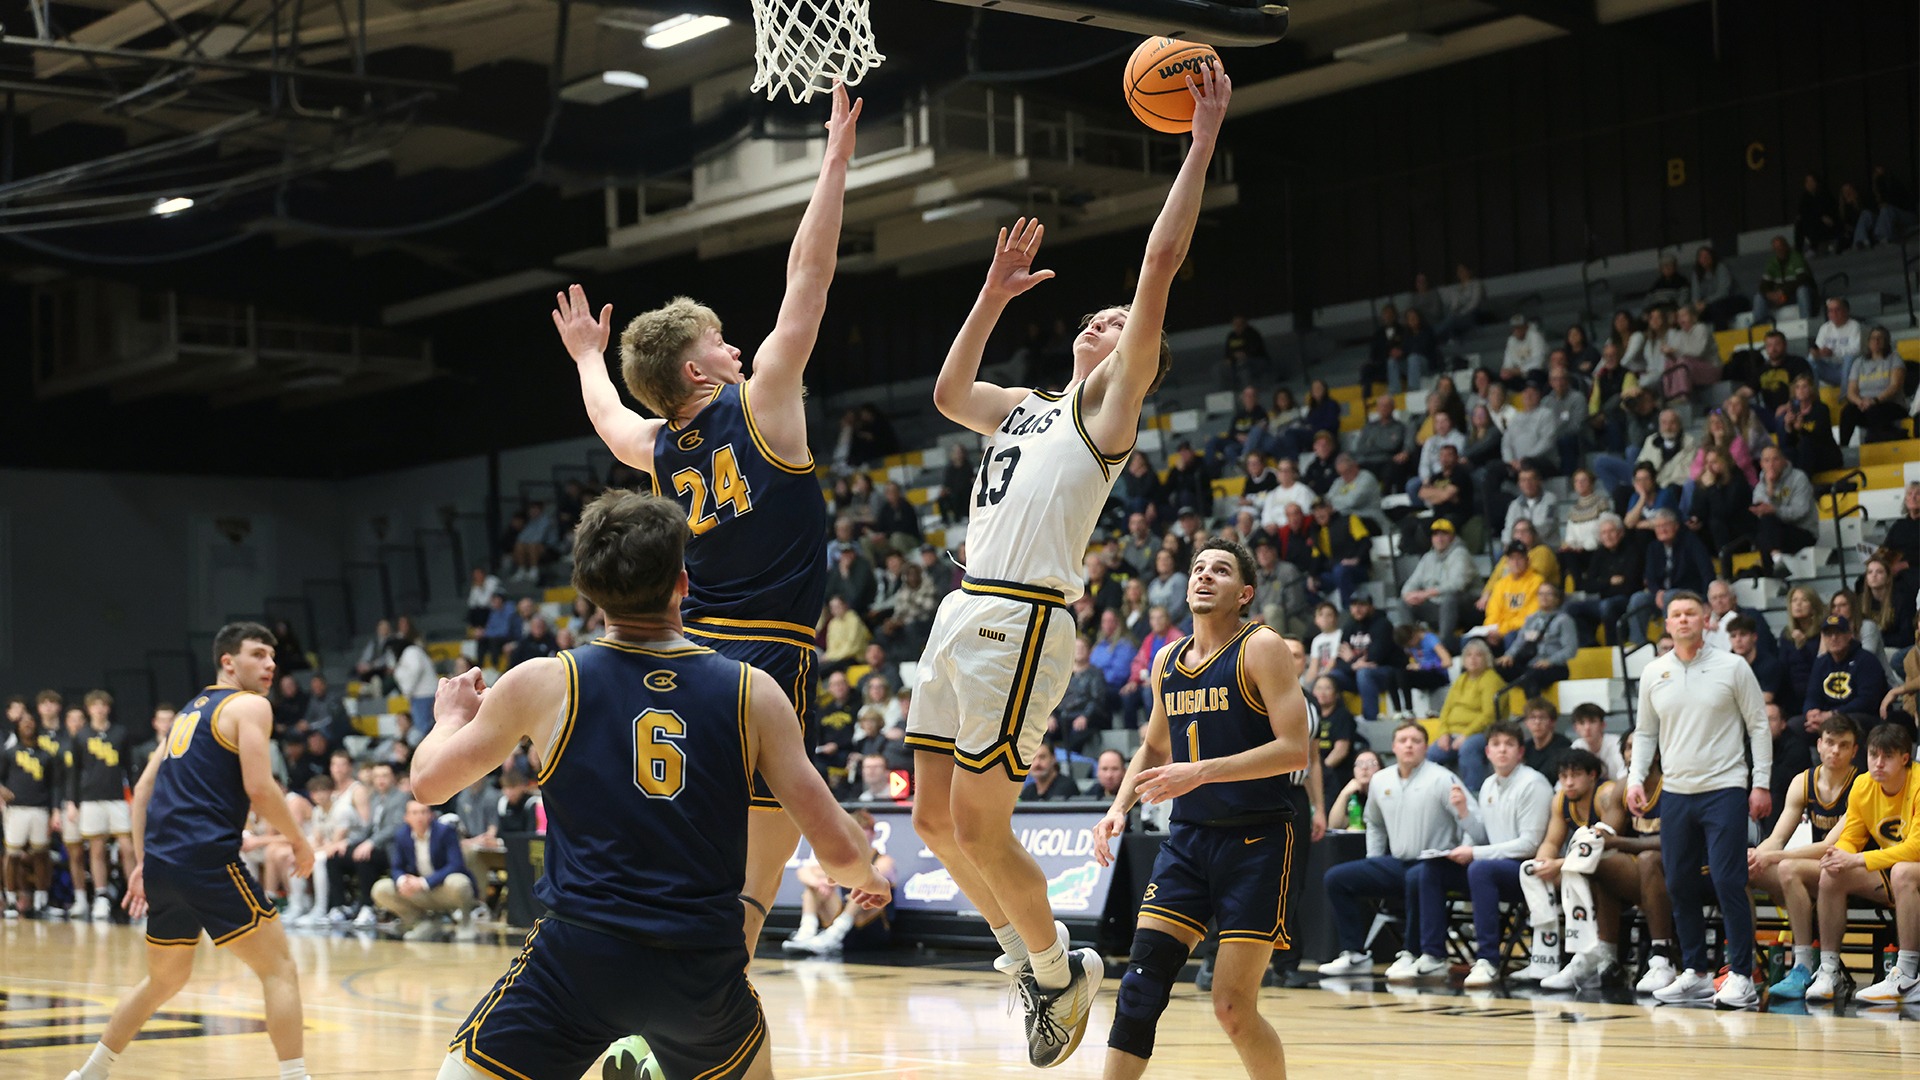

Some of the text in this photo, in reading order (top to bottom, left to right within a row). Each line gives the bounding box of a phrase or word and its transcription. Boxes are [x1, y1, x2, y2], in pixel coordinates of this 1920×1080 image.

[1667, 158, 1685, 187] B
[671, 443, 753, 538] 24
[976, 446, 1021, 508] 13
[162, 710, 202, 760] 10
[632, 707, 687, 801] 6
[1186, 720, 1200, 763] 1
[1013, 828, 1095, 856] UGOLD
